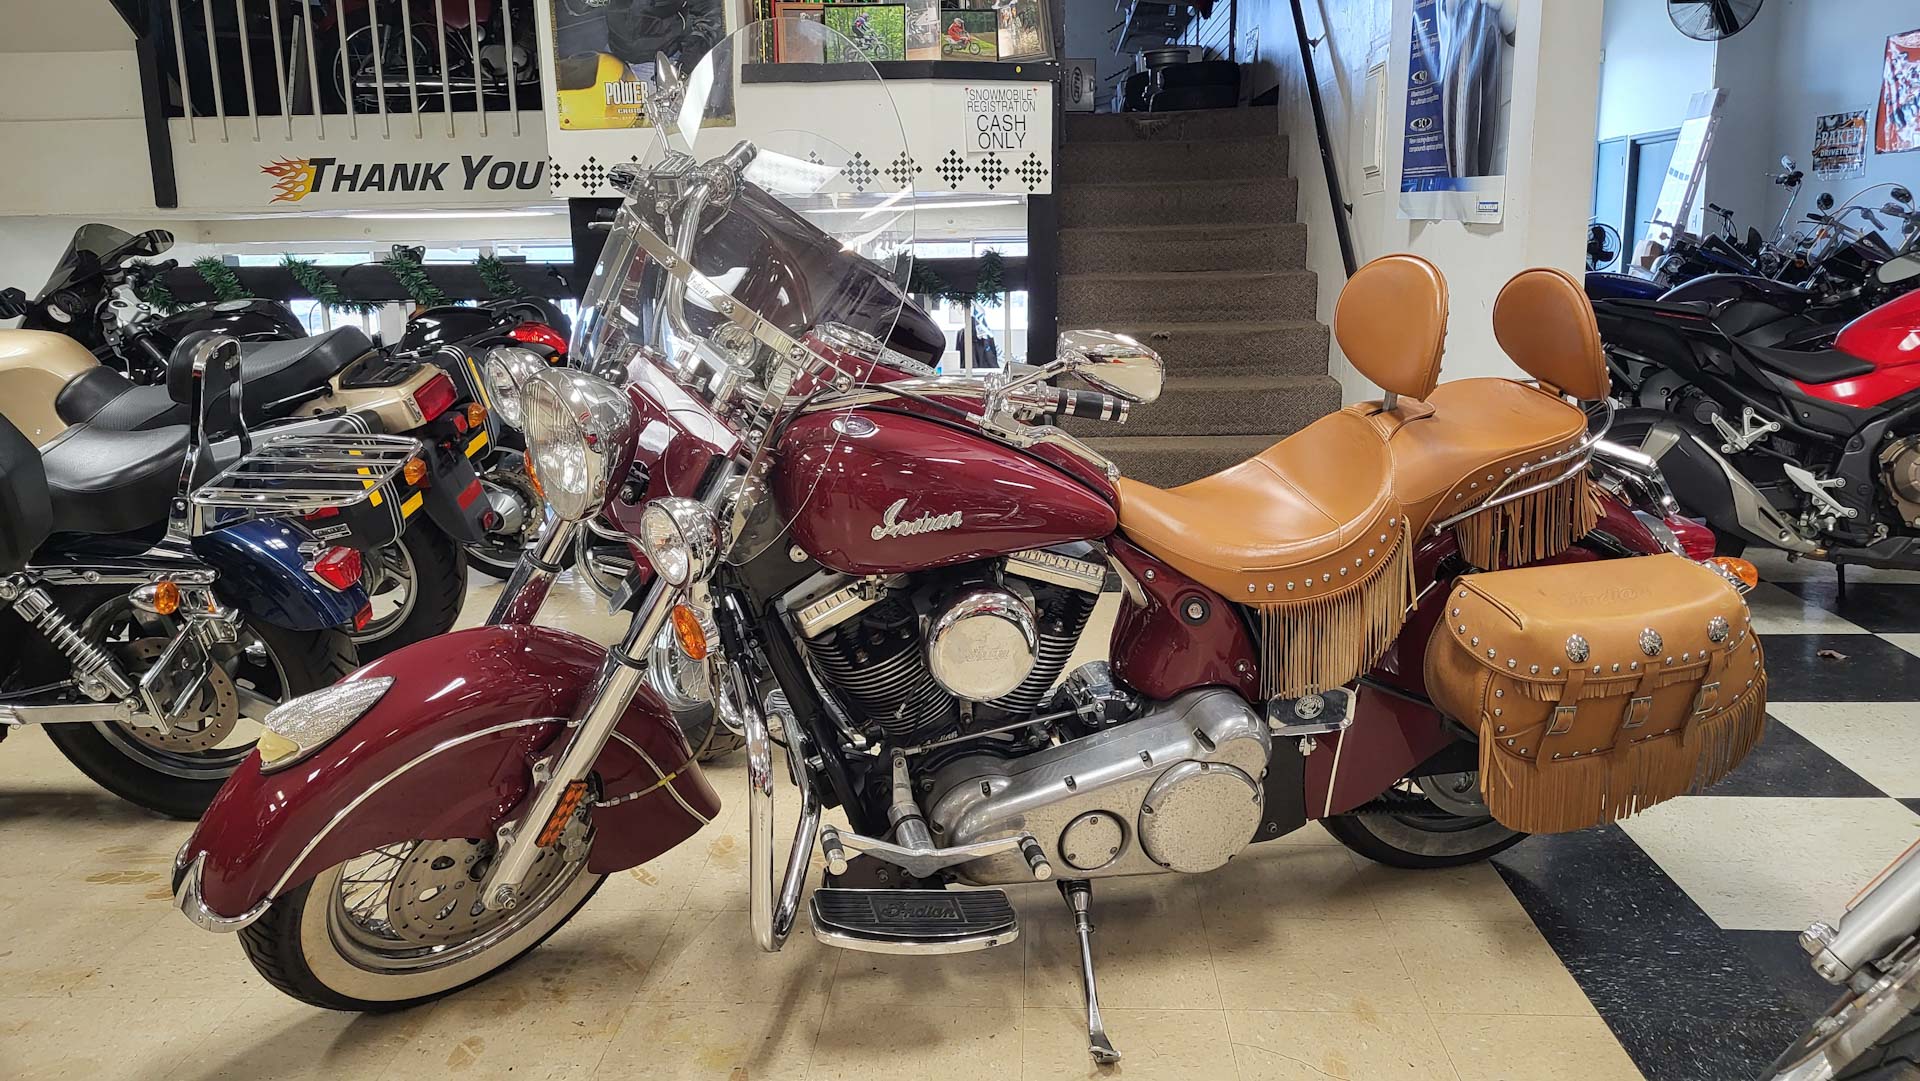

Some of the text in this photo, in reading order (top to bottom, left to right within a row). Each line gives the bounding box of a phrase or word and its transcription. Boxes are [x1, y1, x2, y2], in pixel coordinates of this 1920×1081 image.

[605, 81, 649, 105] POWER
[969, 88, 1033, 101] SNOWMOBILE
[967, 101, 1036, 113] REGISTRATION
[976, 114, 1027, 132] CASH
[978, 132, 1027, 150] ONLY
[1821, 128, 1861, 146] BAKER
[308, 155, 546, 193] THANK YOU
[871, 497, 963, 541] Indian
[880, 900, 959, 920] Indian
